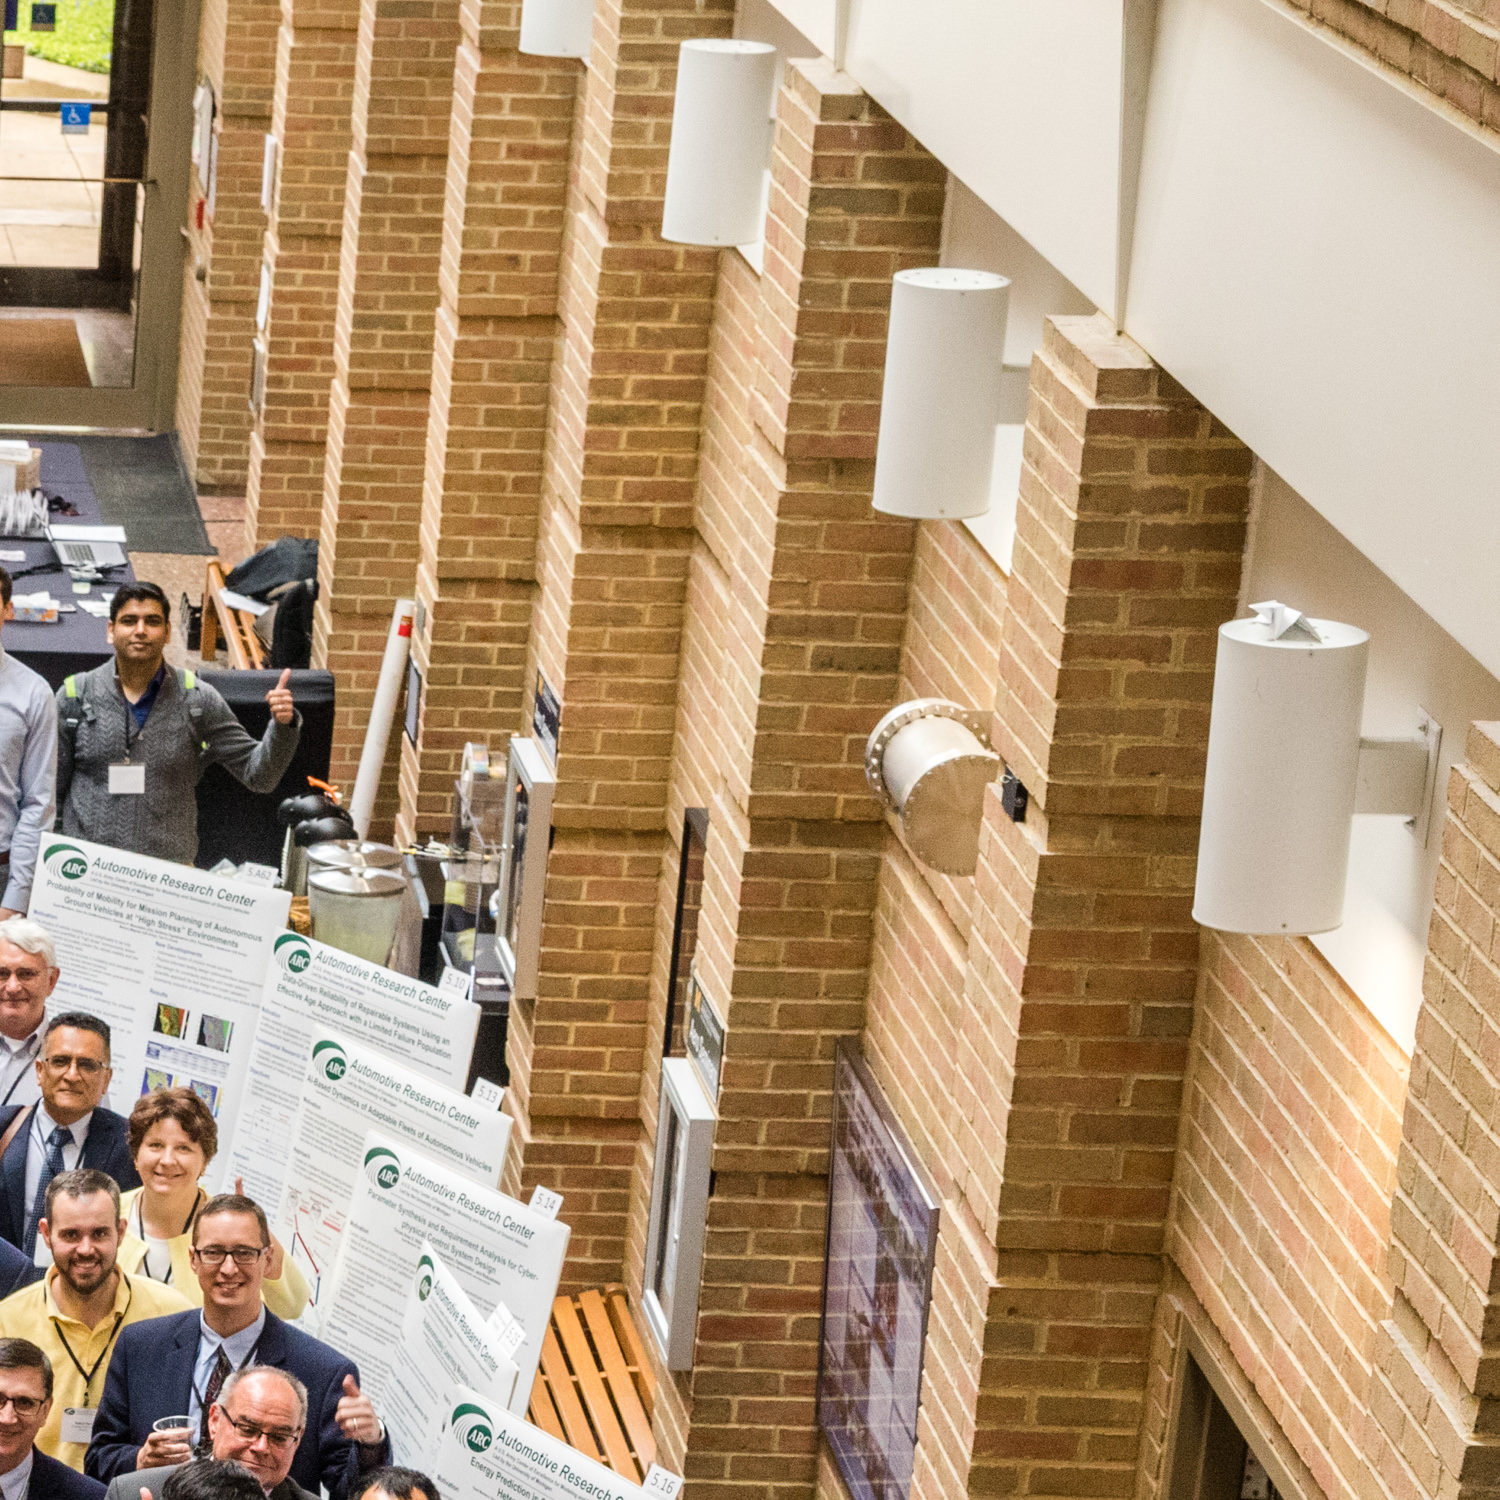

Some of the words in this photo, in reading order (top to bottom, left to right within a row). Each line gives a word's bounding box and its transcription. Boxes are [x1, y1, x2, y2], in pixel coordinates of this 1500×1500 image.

[62, 862, 87, 877] ARC
[247, 868, 272, 881] 5.A62
[93, 857, 157, 882] Automotive
[159, 874, 213, 896] Research
[216, 888, 256, 906] Center
[289, 954, 310, 969] ARC
[315, 951, 369, 980] Automotive
[370, 971, 416, 998] Research
[418, 989, 451, 1010] Center
[445, 973, 466, 991] 5.10
[326, 1061, 346, 1077] ARC
[351, 1059, 401, 1092] Automotive
[402, 1084, 446, 1113] Research
[447, 1106, 480, 1128] Center
[477, 1084, 498, 1103] 5.13
[378, 1168, 399, 1185] ARC
[403, 1167, 455, 1200] Automotive
[456, 1193, 500, 1222] Research
[502, 1215, 535, 1238] Center
[536, 1194, 556, 1210] 5.14
[467, 1428, 492, 1449] ARC
[497, 1429, 558, 1471] Automotive
[559, 1464, 611, 1500] Research
[650, 1474, 675, 1494] 5.16
